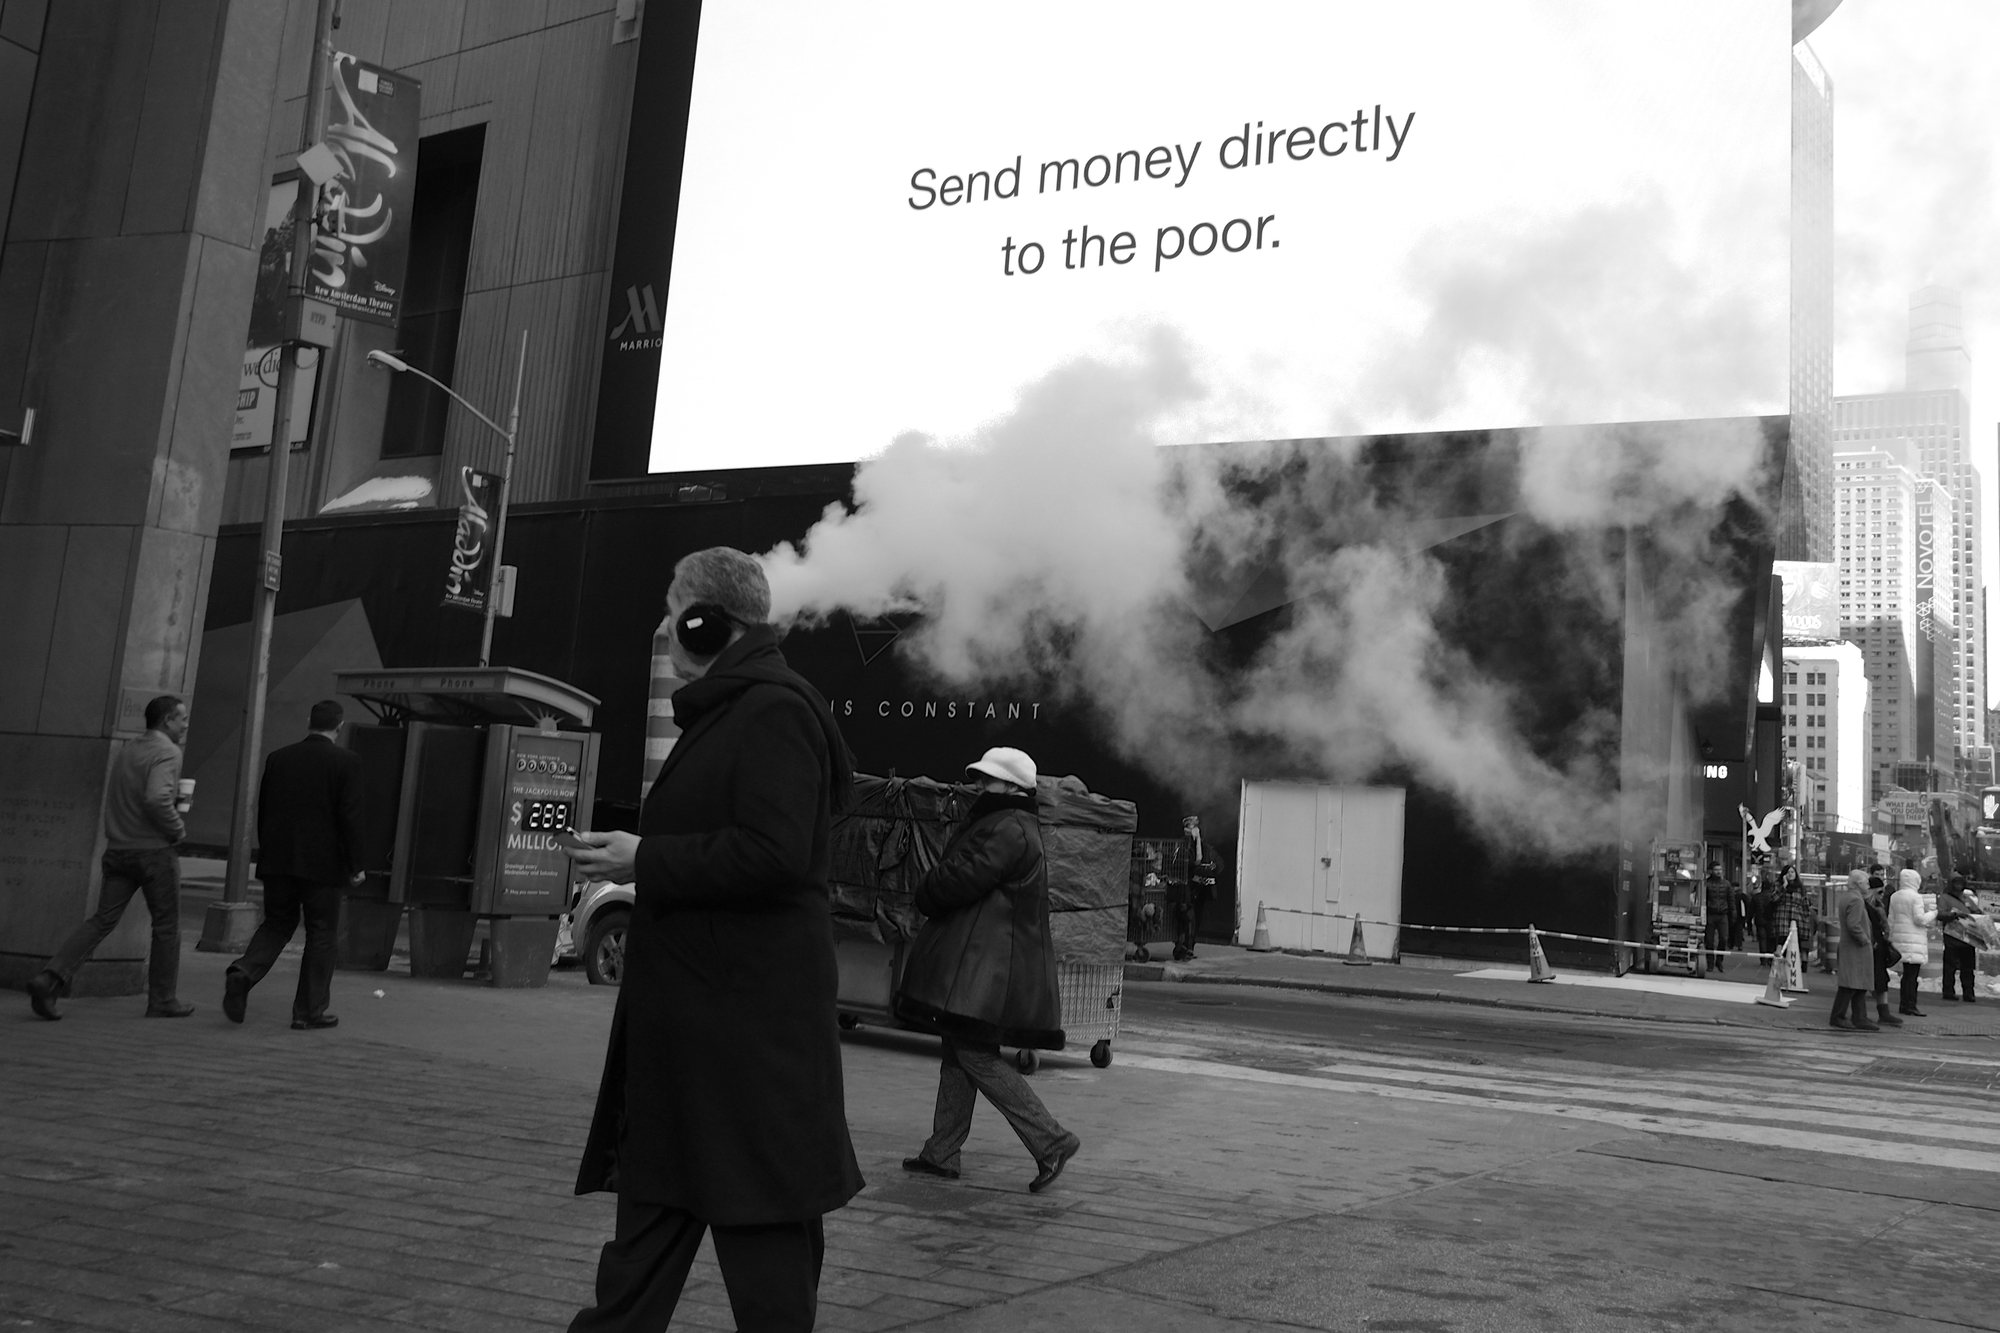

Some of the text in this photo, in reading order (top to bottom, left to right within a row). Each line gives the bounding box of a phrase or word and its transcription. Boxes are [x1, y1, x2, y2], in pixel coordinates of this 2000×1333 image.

[908, 104, 1416, 211] Send money directly
[1001, 213, 1281, 277] to the poor.
[315, 285, 394, 311] New Amsterdam Theatre
[1916, 493, 1934, 589] NOVOTEL
[441, 679, 475, 689] Phone
[830, 699, 1041, 720] IS CONSTANT
[513, 786, 524, 794] THE
[524, 787, 553, 796] JACKPOT
[529, 802, 568, 829] 289
[507, 834, 562, 851] MILLIO
